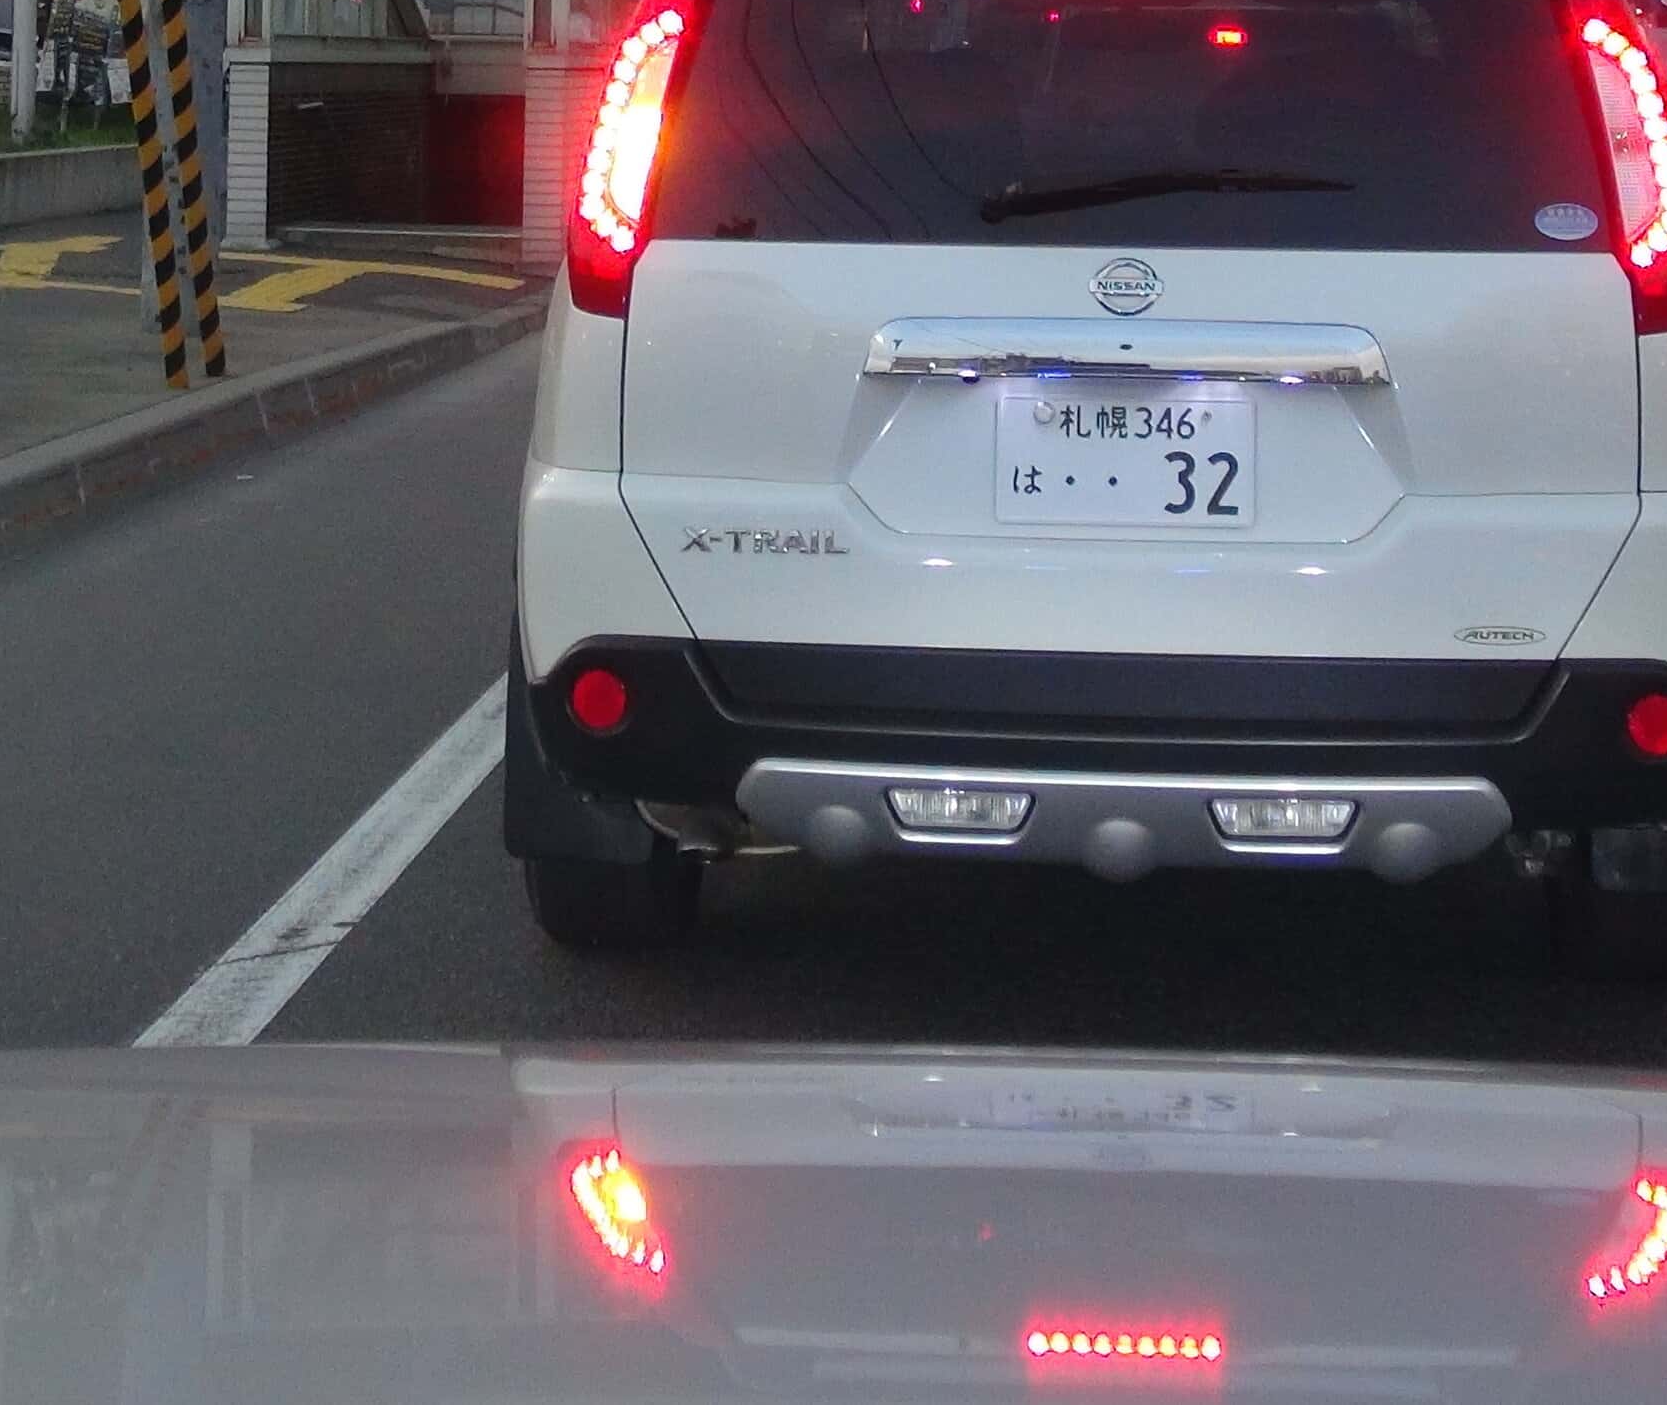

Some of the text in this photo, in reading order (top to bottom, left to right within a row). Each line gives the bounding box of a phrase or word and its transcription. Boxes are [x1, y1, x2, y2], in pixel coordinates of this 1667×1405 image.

[1095, 280, 1157, 293] NISSAN
[681, 525, 851, 557] X-TRAIL
[1463, 628, 1538, 643] AUTECH
